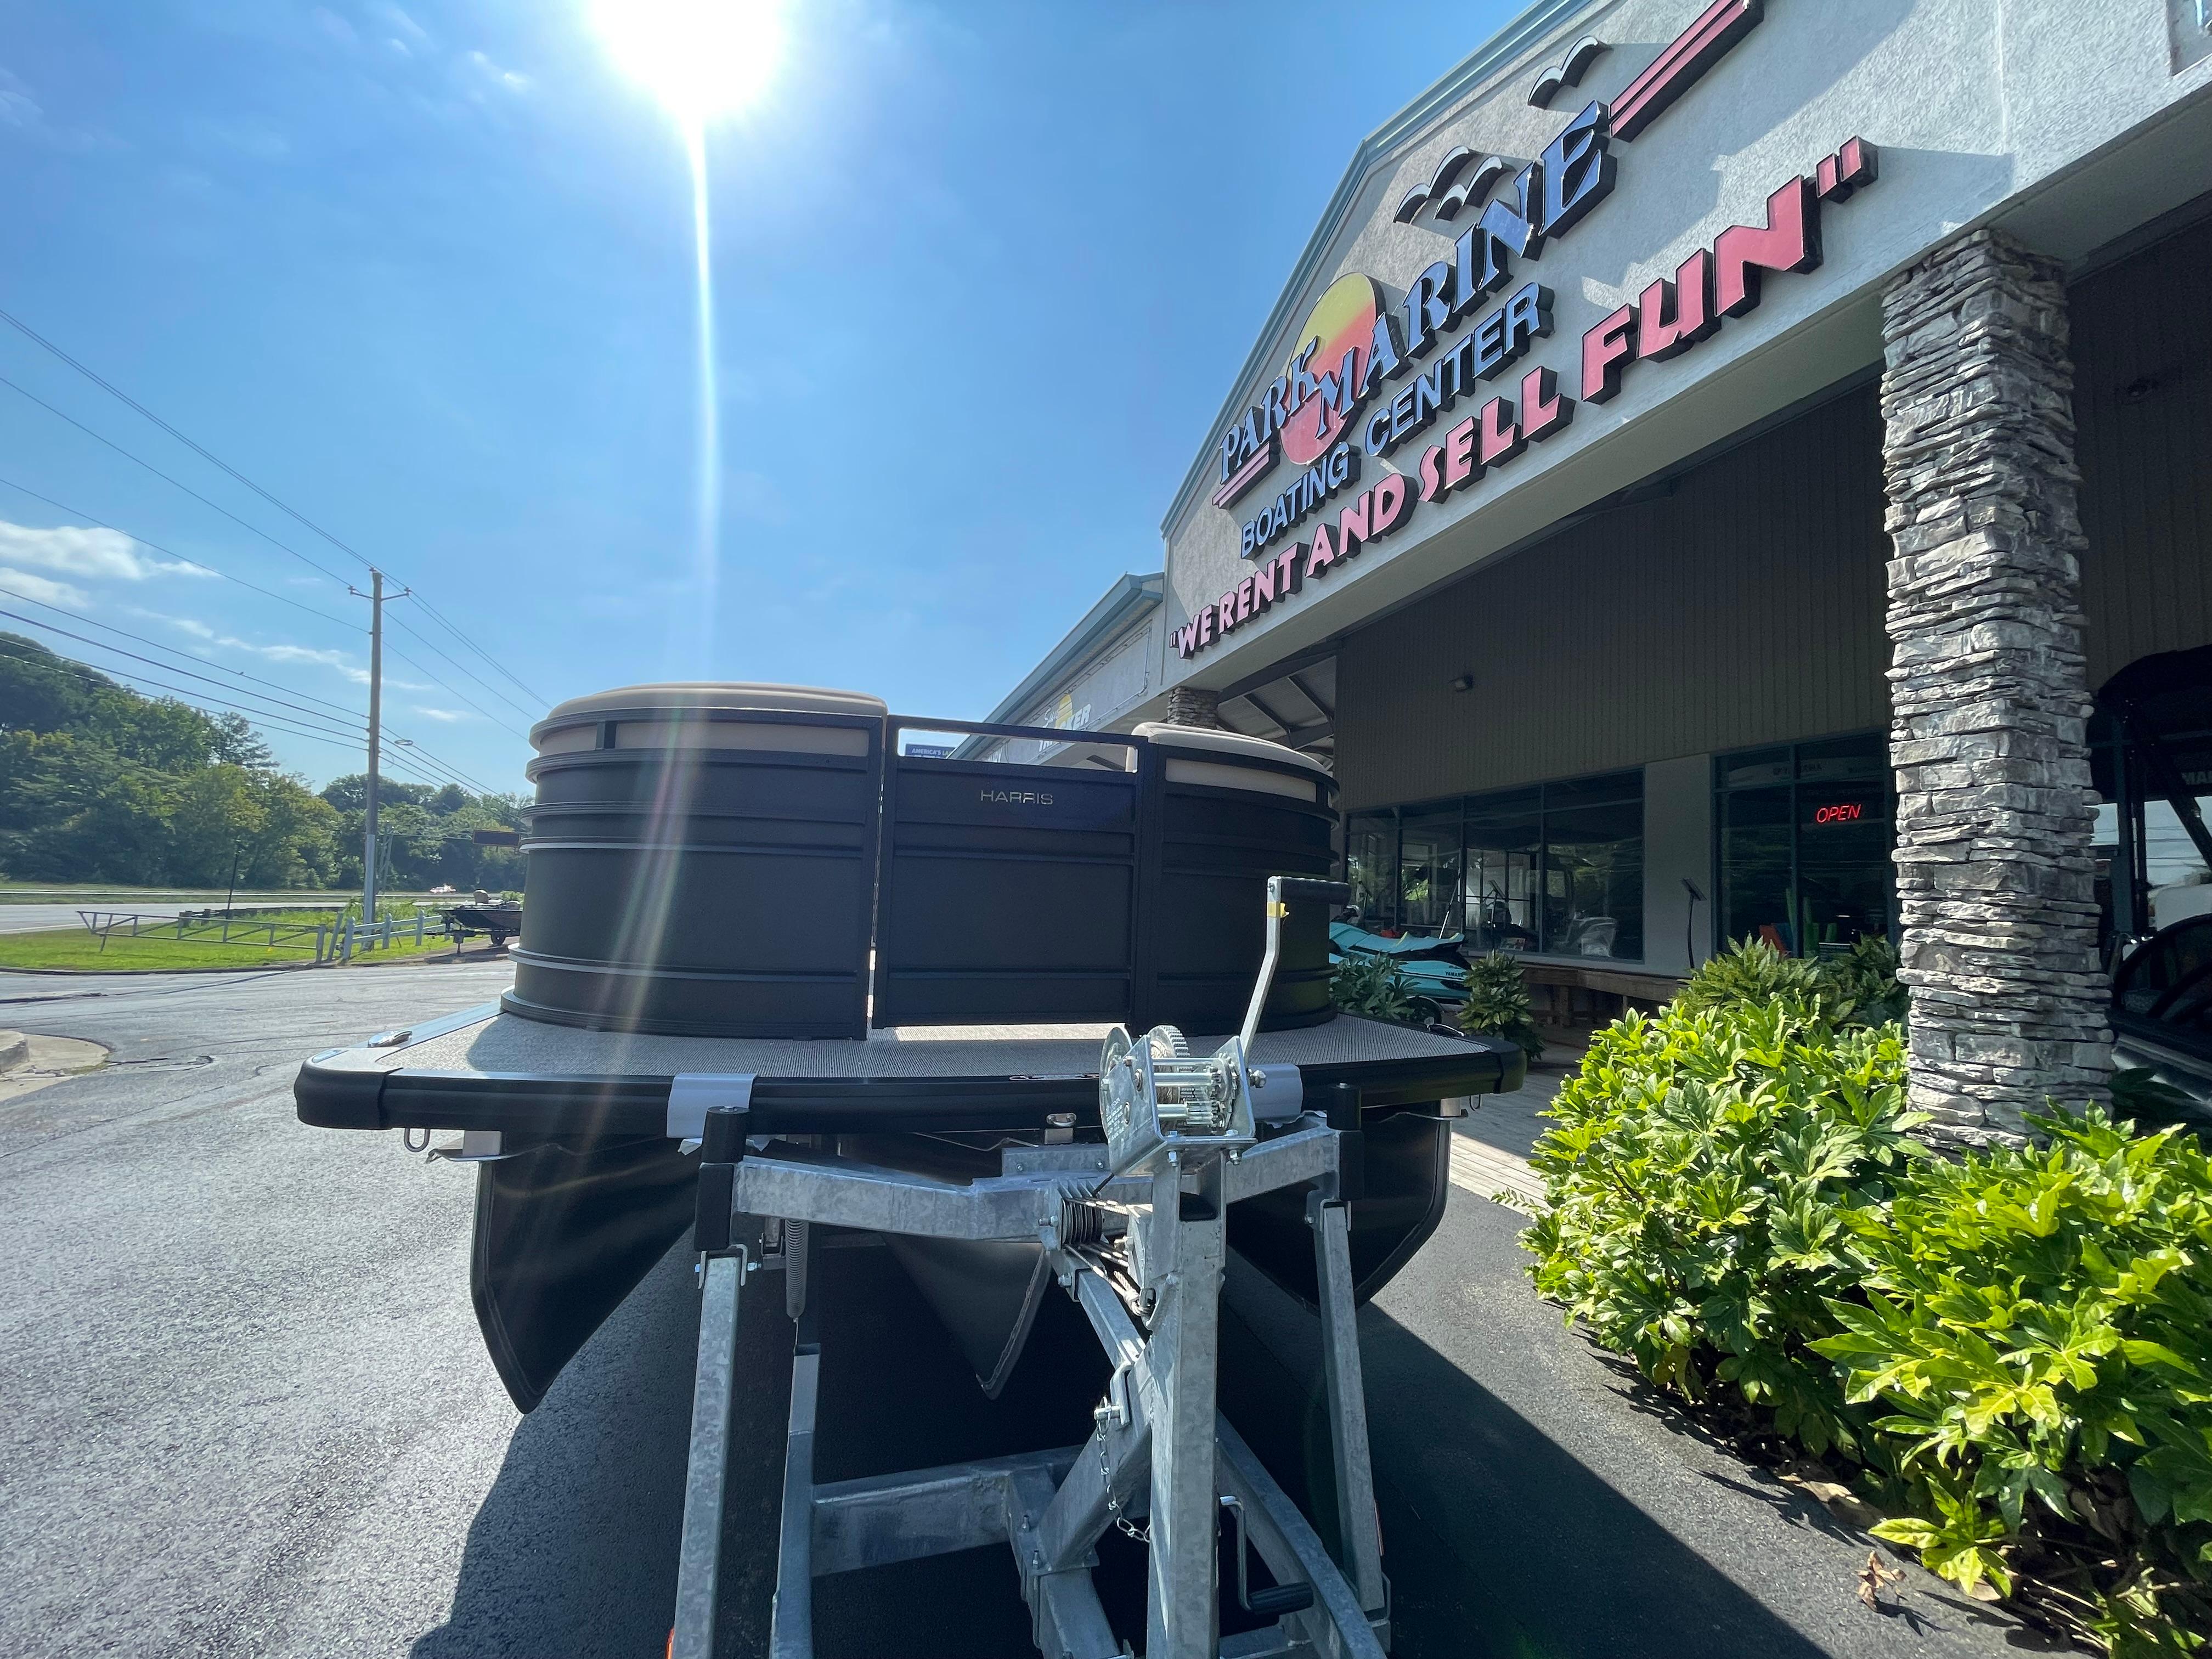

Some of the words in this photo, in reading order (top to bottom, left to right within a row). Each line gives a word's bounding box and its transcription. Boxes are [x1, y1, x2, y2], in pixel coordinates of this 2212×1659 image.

[1169, 604, 1213, 658] "WE
[1218, 541, 1299, 635] RENT
[1305, 472, 1406, 578] AND
[1418, 365, 1561, 501] SELL
[1581, 135, 1861, 402] FUN"
[1219, 335, 1319, 484] PARK
[1315, 99, 1601, 439] MARINE
[1240, 441, 1349, 560] BOATING
[1365, 281, 1541, 456] CENTER
[980, 789, 1053, 805] HARRIS
[1816, 804, 1861, 823] OPEN
